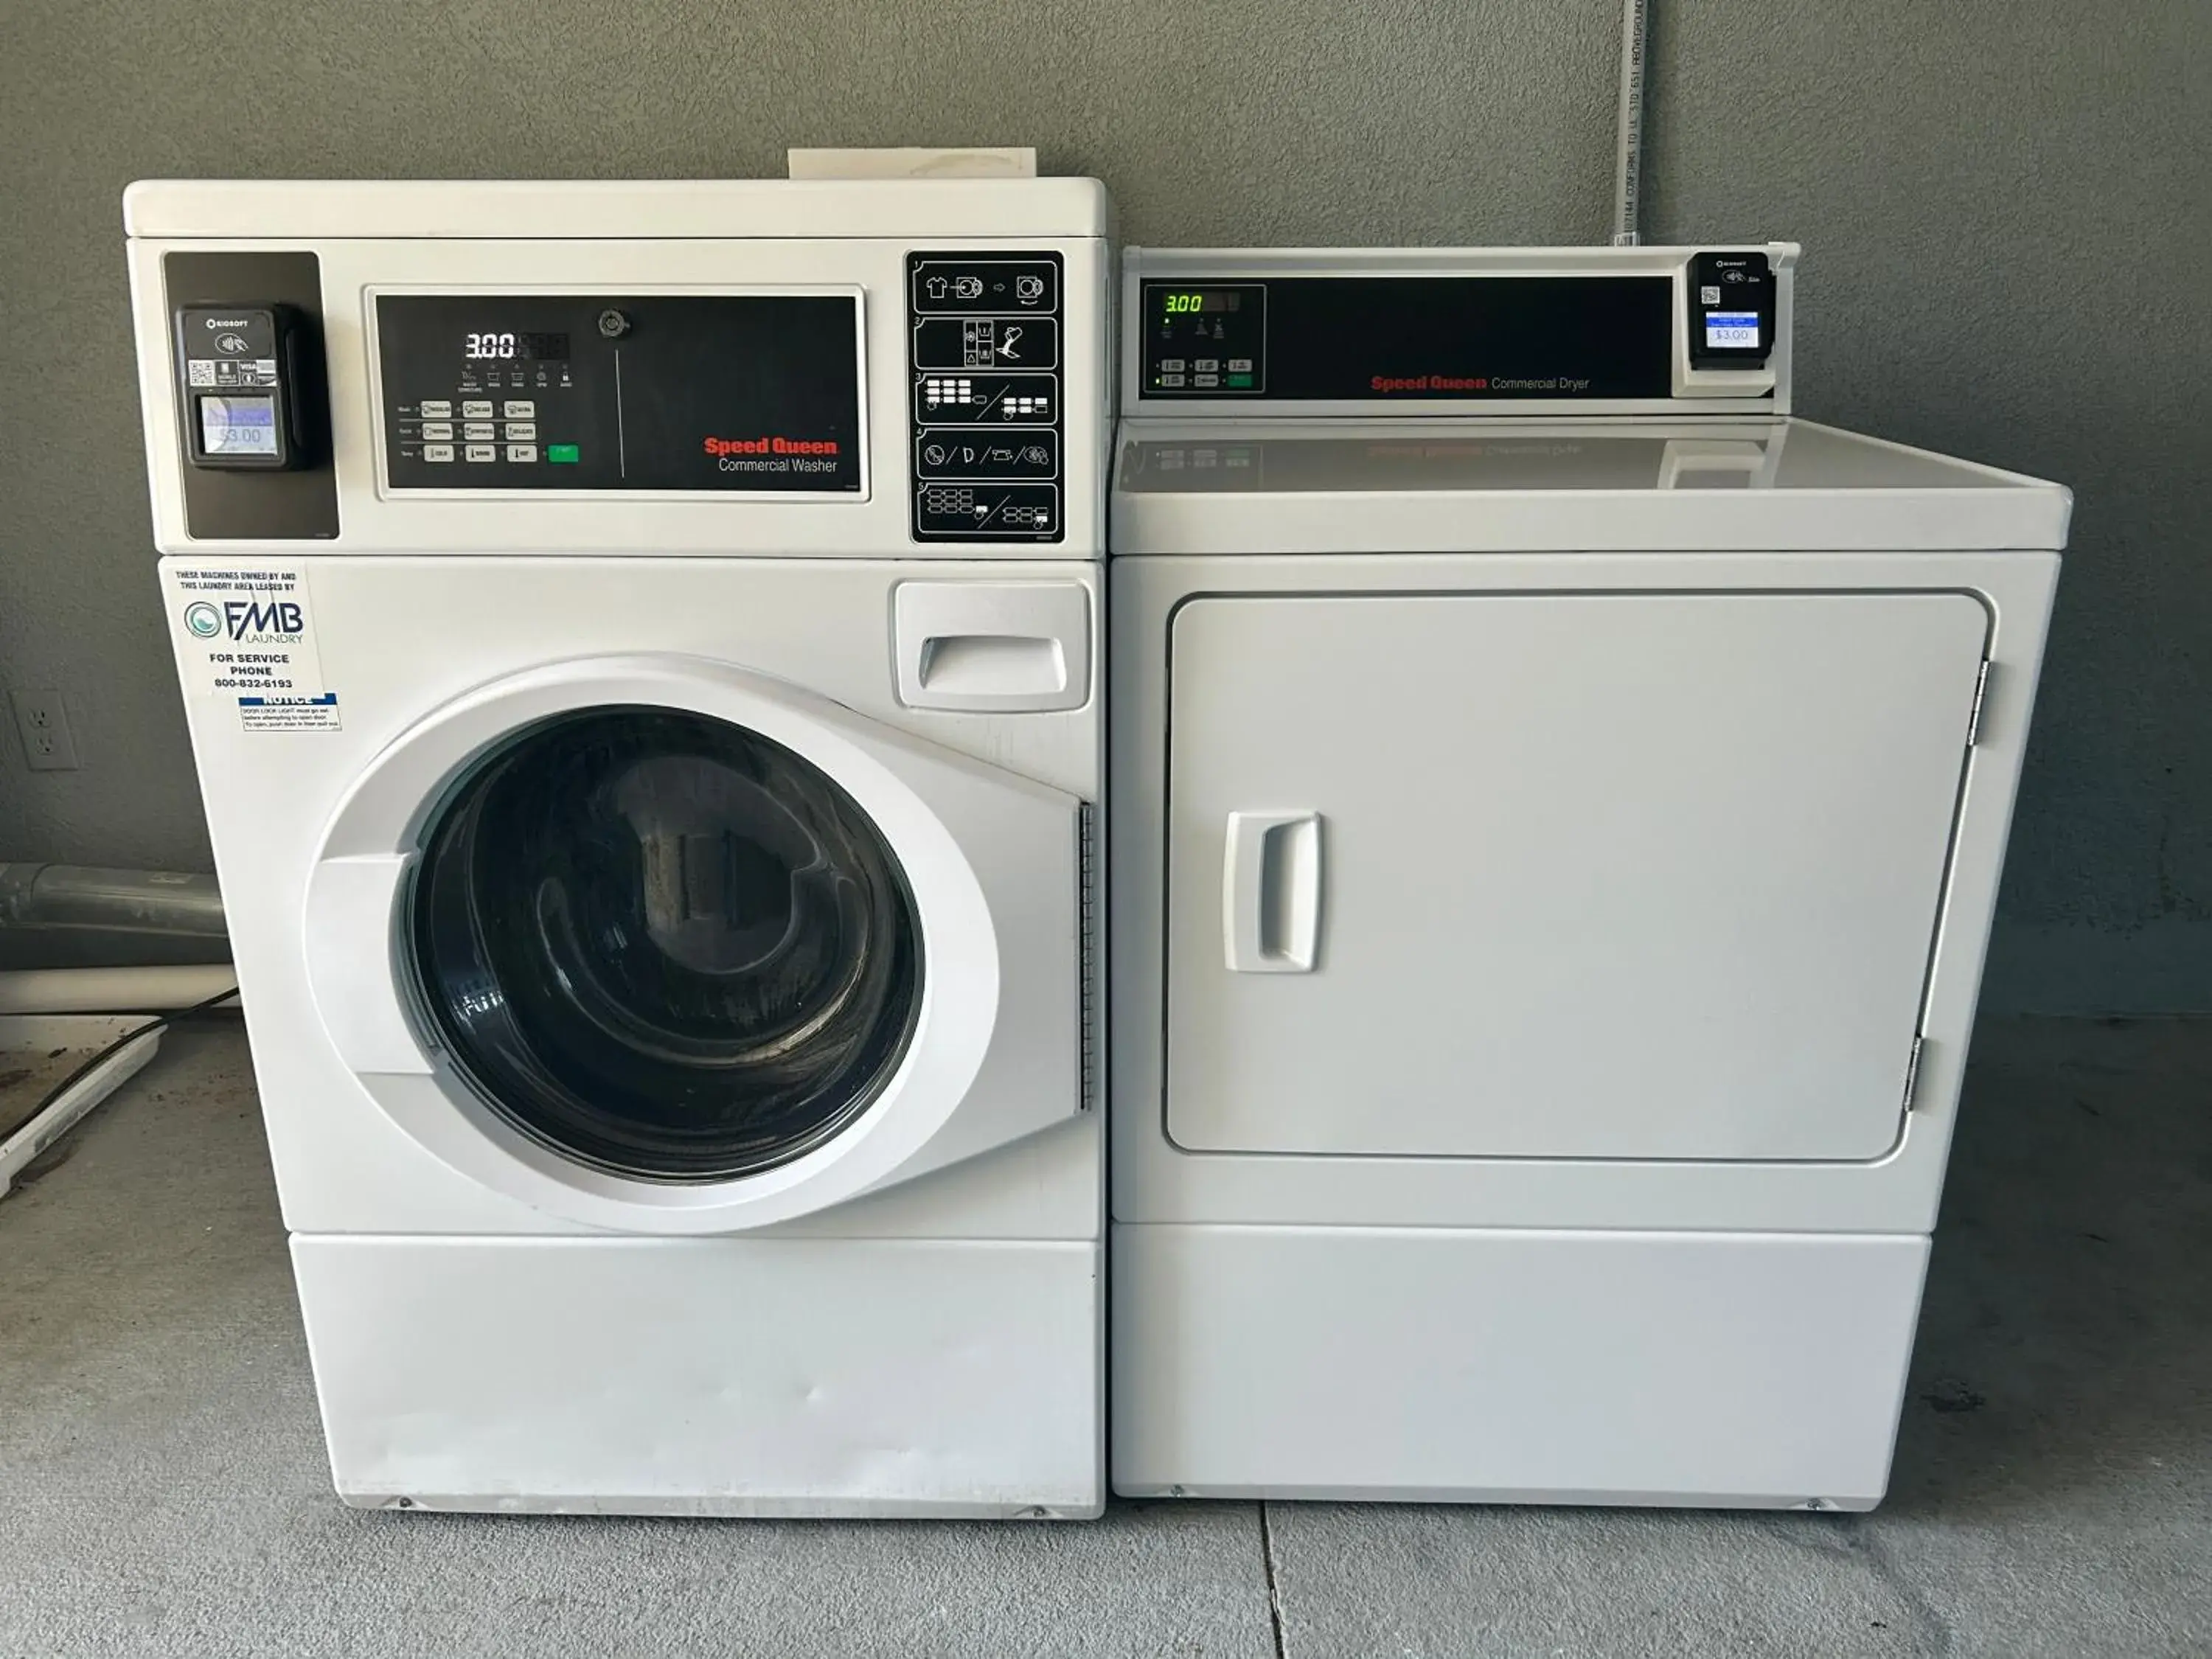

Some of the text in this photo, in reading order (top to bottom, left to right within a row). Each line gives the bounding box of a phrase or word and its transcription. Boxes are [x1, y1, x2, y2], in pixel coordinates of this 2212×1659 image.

[1630, 72, 1640, 88] 651
[1629, 94, 1639, 111] STD
[1627, 133, 1638, 145] TO
[1371, 375, 1589, 392] Speed Queen Commercial Dryer
[704, 437, 838, 456] Speed Queen
[718, 458, 838, 473] Commercial Washer
[201, 571, 240, 580] MACHINES
[240, 571, 268, 580] OWNED
[268, 572, 279, 580] BY
[281, 572, 296, 581] AND
[198, 582, 232, 590] LAUNDRY
[234, 582, 254, 591] AREA
[255, 582, 283, 591] LEASED
[223, 601, 304, 641] FMB
[246, 634, 303, 644] LAUNDRY
[209, 654, 290, 664] FOR SERVICE
[230, 666, 272, 675] PHONE
[215, 678, 293, 688] 800-832-6193
